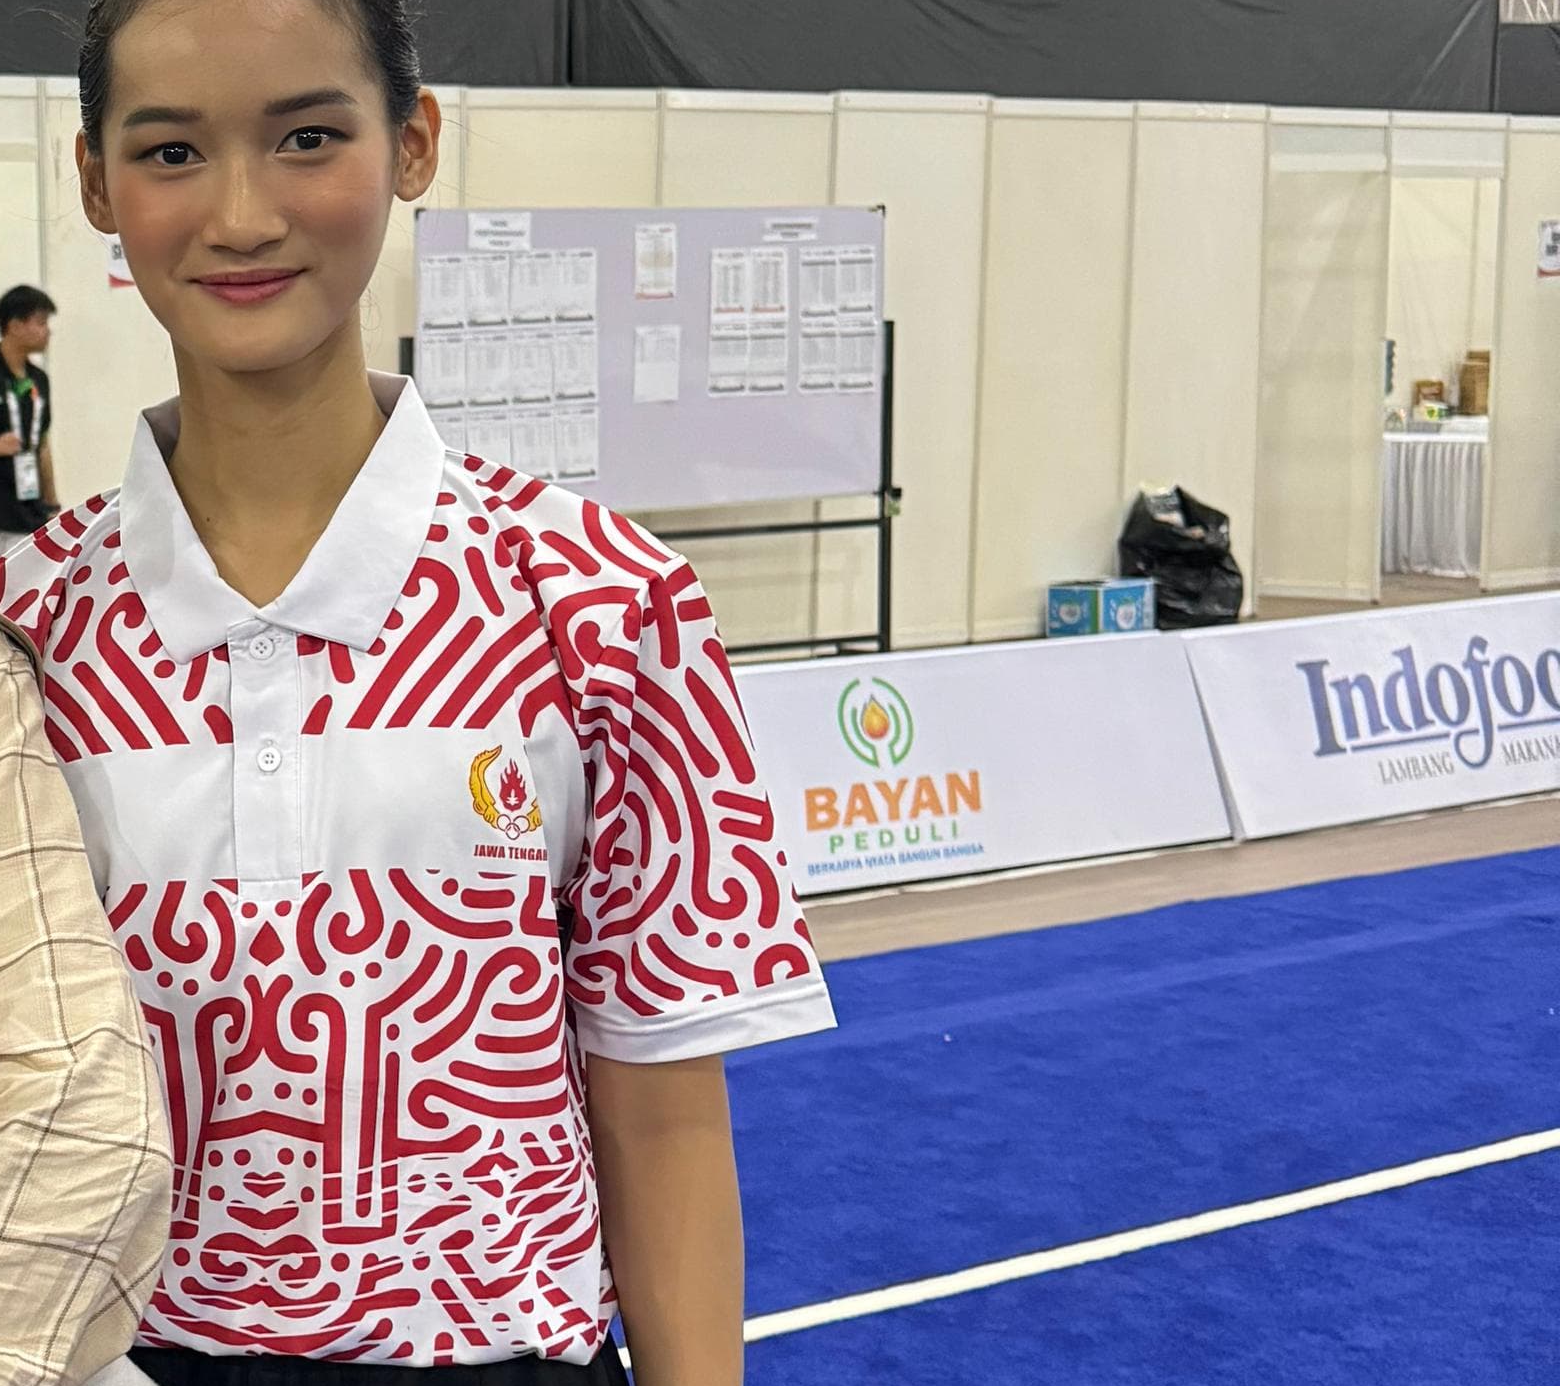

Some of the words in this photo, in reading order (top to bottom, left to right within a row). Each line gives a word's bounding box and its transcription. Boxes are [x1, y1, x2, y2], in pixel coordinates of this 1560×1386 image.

[1378, 752, 1454, 785] LAMBANG
[804, 769, 982, 832] BAYAN
[474, 844, 506, 859] JAWA
[829, 819, 959, 854] PEDULI
